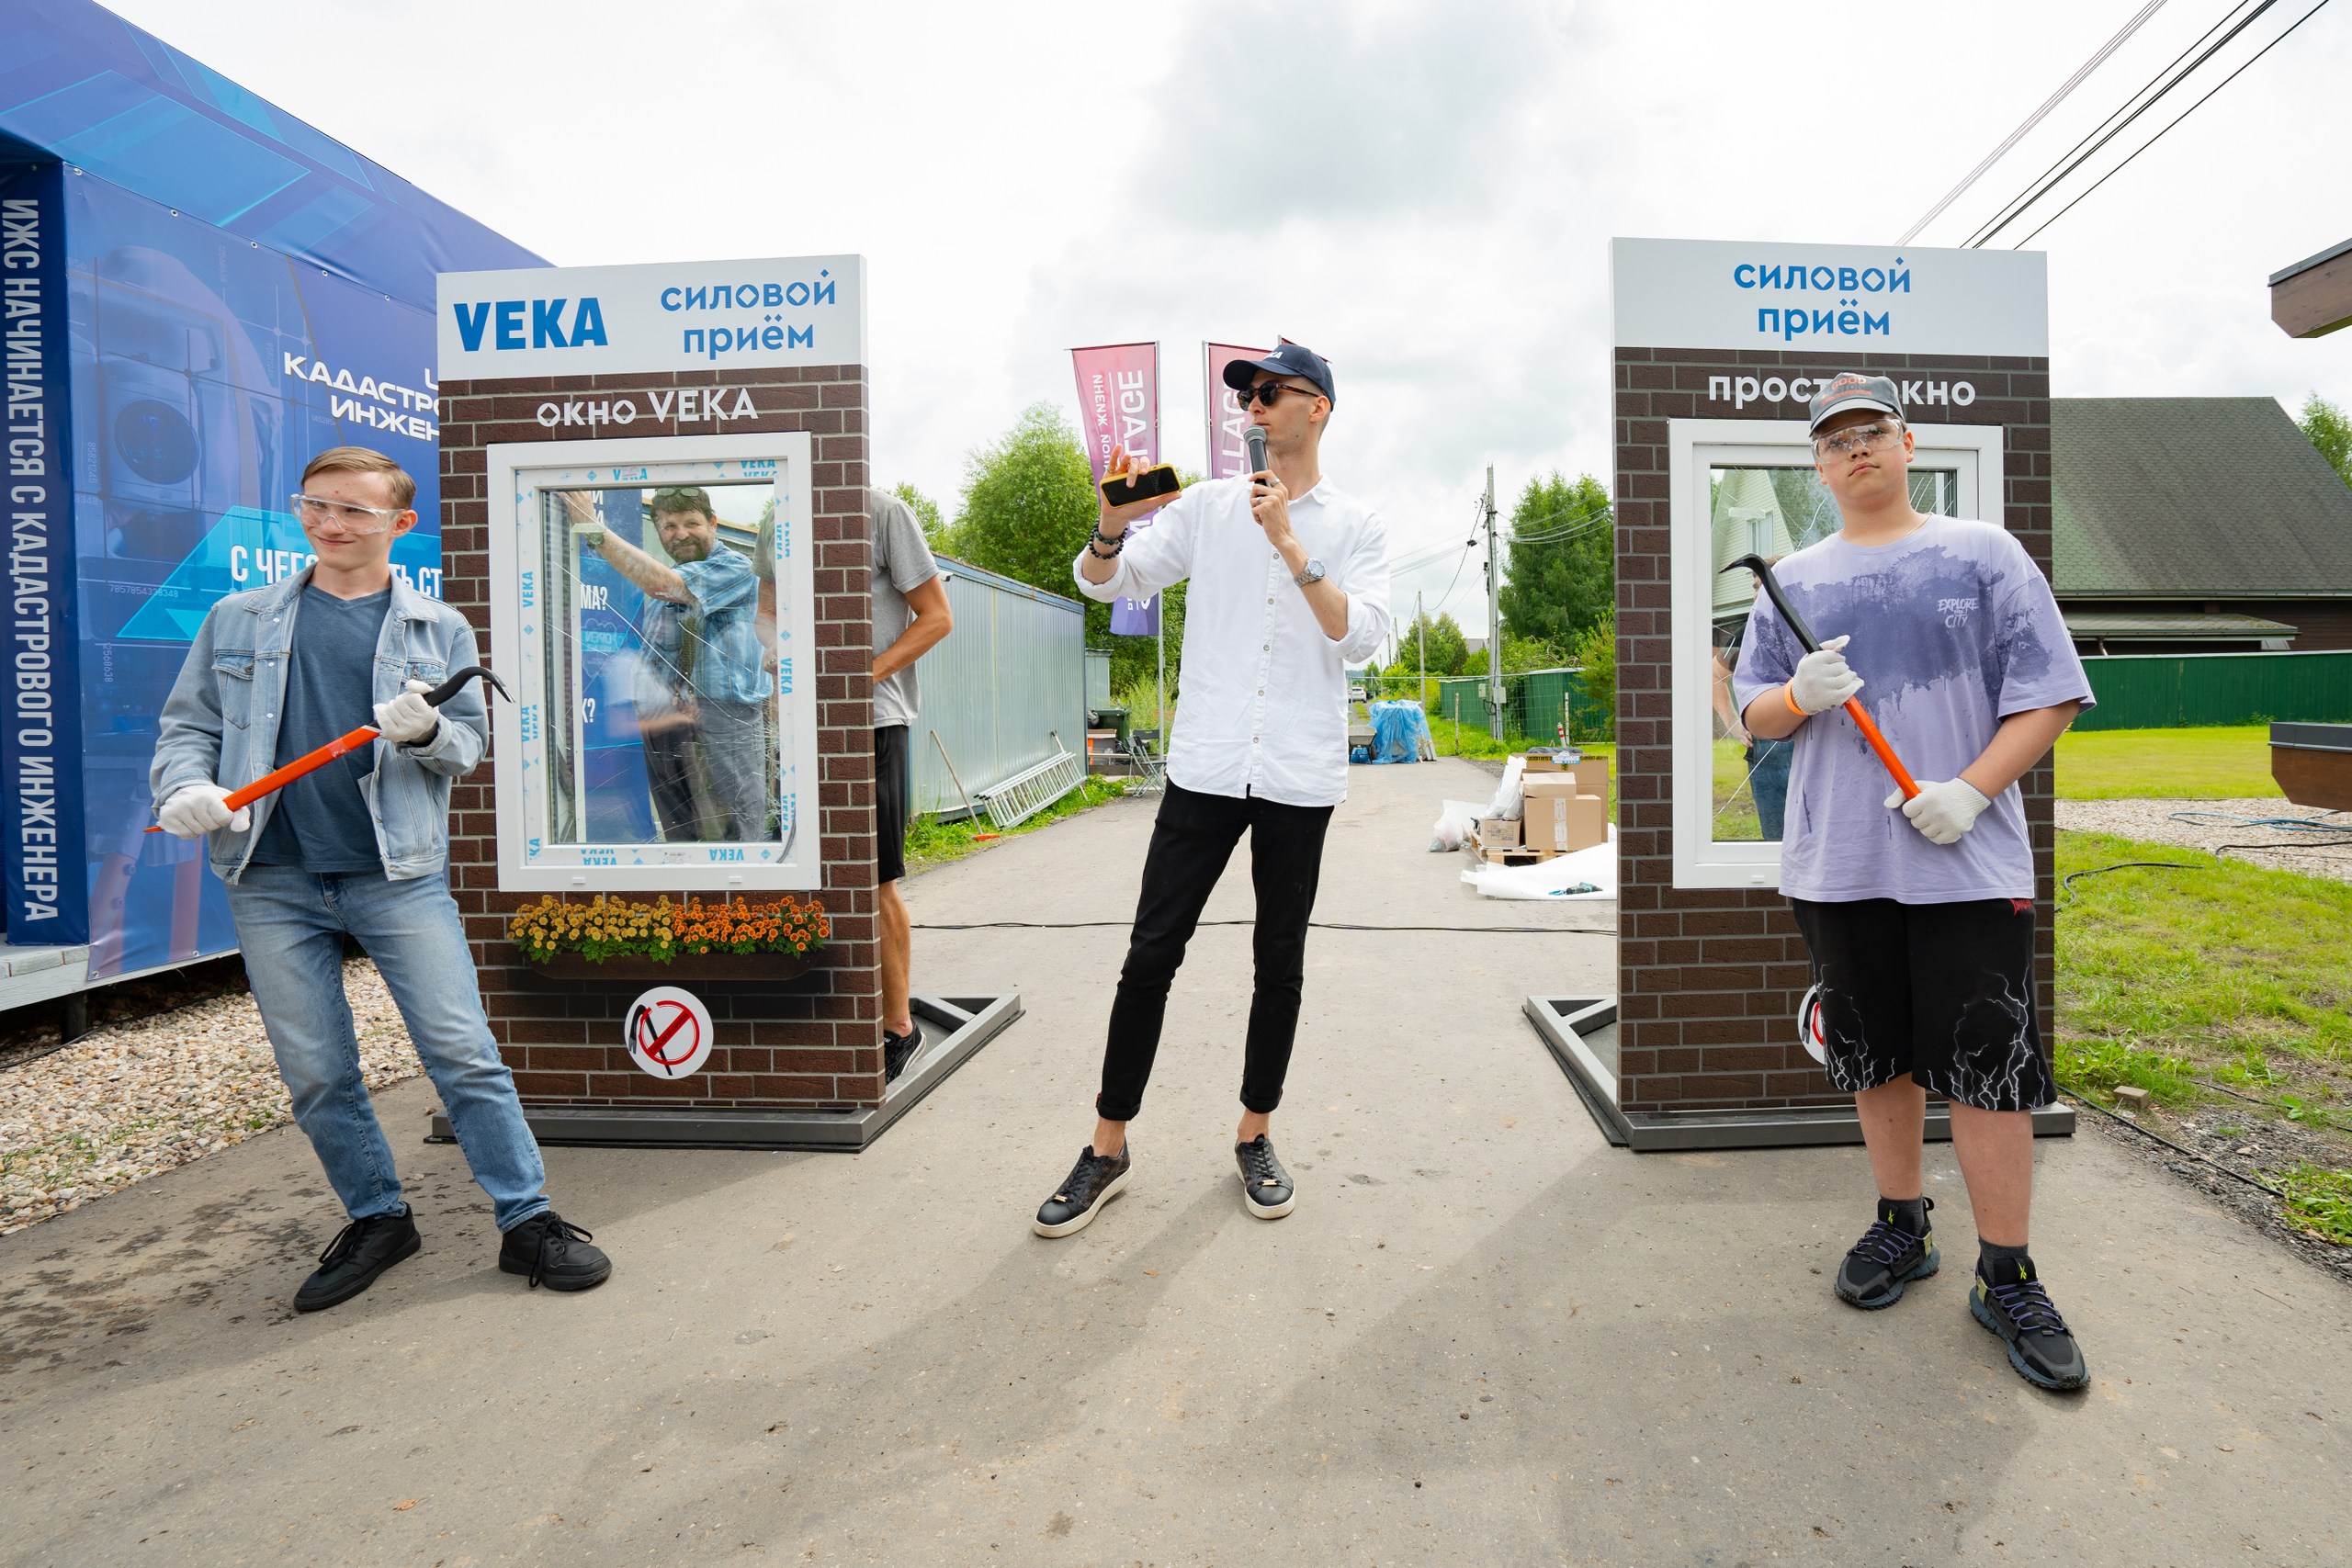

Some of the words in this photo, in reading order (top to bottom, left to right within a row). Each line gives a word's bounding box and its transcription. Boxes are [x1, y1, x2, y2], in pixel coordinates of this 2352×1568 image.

[2, 199, 40, 269] ИЖС
[661, 268, 835, 311] силовой
[1734, 256, 1910, 293] силовой
[453, 297, 608, 352] VEKA
[684, 314, 814, 360] приём
[1758, 299, 1890, 341] приём
[5, 278, 45, 476] НАЧИНАЕТСЯ
[1709, 376, 1836, 410] прост
[1899, 379, 1975, 406] кно
[1831, 376, 1867, 390] GOOD
[537, 399, 637, 428] окно
[647, 387, 759, 423] VEKA
[10, 485, 46, 503] С
[231, 545, 248, 582] С
[522, 571, 534, 608] VEKA
[1937, 597, 1979, 615] EXPLORE
[8, 513, 52, 747] КАДАСТРОВОГО
[1944, 614, 1969, 629] CITY
[780, 657, 793, 695] VEKA
[18, 756, 58, 921] ИНЖЕНЕРА
[708, 848, 745, 862] VEKA
